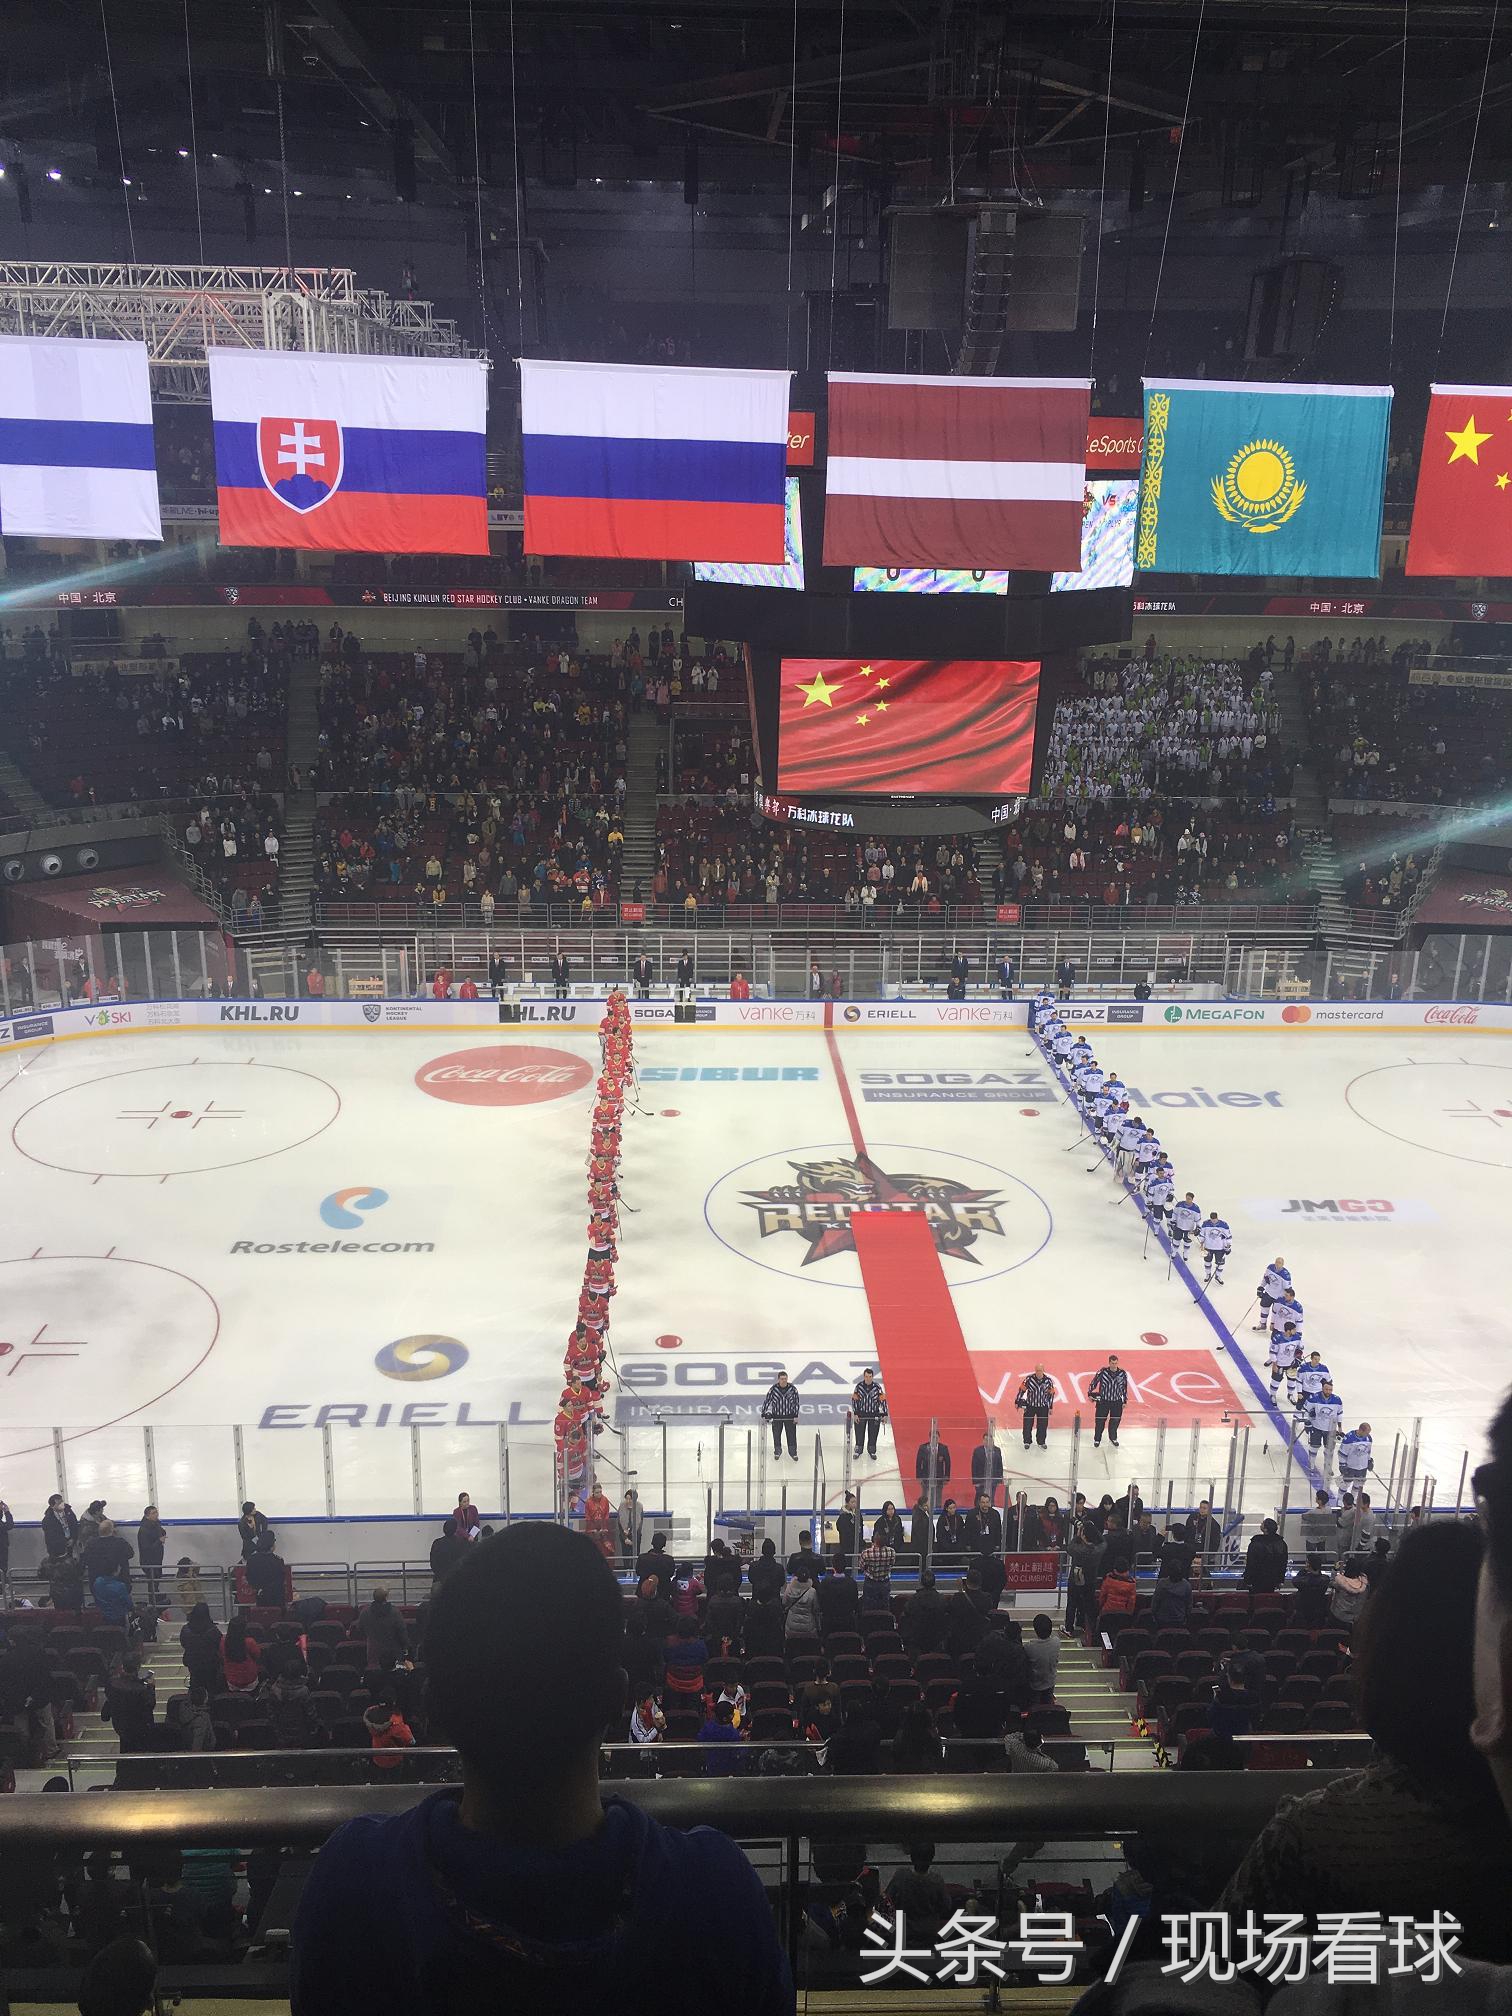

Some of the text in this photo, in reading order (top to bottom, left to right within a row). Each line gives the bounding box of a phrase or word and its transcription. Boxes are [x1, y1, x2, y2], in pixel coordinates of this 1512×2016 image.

[383, 593, 598, 605] BEIJING KUNLUN RED STAR HOCKEY CLUB VANKE DRAGON TEAM
[220, 1005, 300, 1021] KHL.RU
[519, 1006, 577, 1021] HL.RU
[634, 1009, 676, 1018] SOGA
[738, 1007, 816, 1021] vanke 万科
[867, 1010, 917, 1019] ERIELL
[936, 1007, 1013, 1021] vanke 万科
[1316, 1010, 1384, 1020] mastercard
[639, 1067, 820, 1081] SIBUR
[859, 1073, 1048, 1085] SOGAZ
[872, 1091, 1049, 1099] INSURANCE GROUP
[230, 1240, 435, 1255] Rostelecom
[258, 1401, 555, 1430] ERIELL
[1020, 1574, 1053, 1582] CLIMBING
